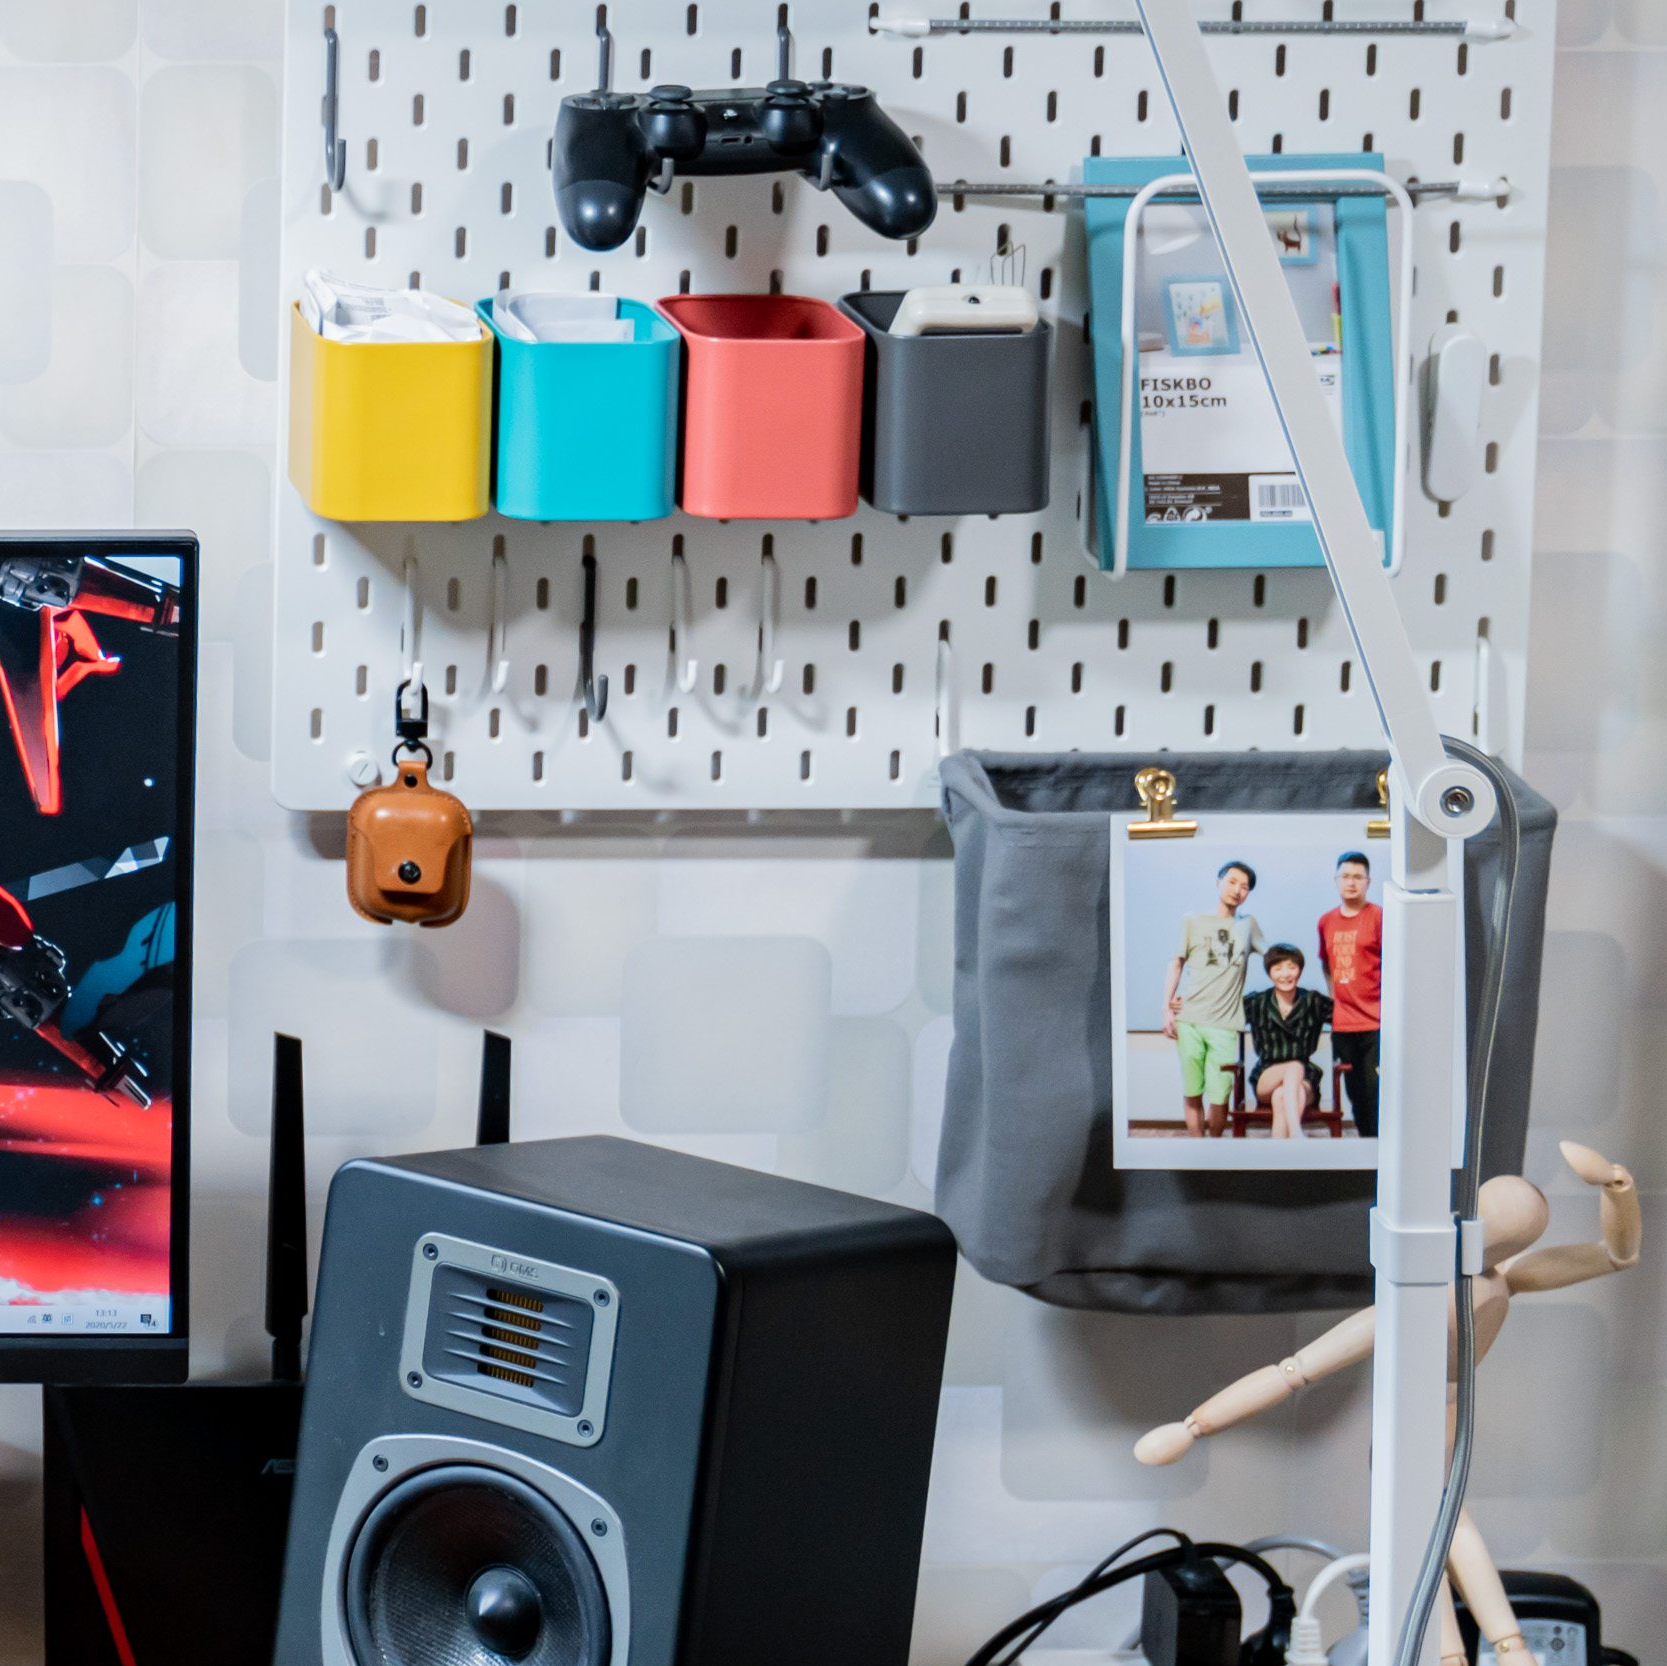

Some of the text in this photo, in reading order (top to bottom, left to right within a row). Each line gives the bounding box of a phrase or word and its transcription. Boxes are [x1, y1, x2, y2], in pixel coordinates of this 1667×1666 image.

[1141, 377, 1212, 392] FISKBO
[1142, 394, 1227, 409] 10x15cm
[95, 1309, 117, 1317] 13:13
[85, 1321, 128, 1329] 2020/5/22
